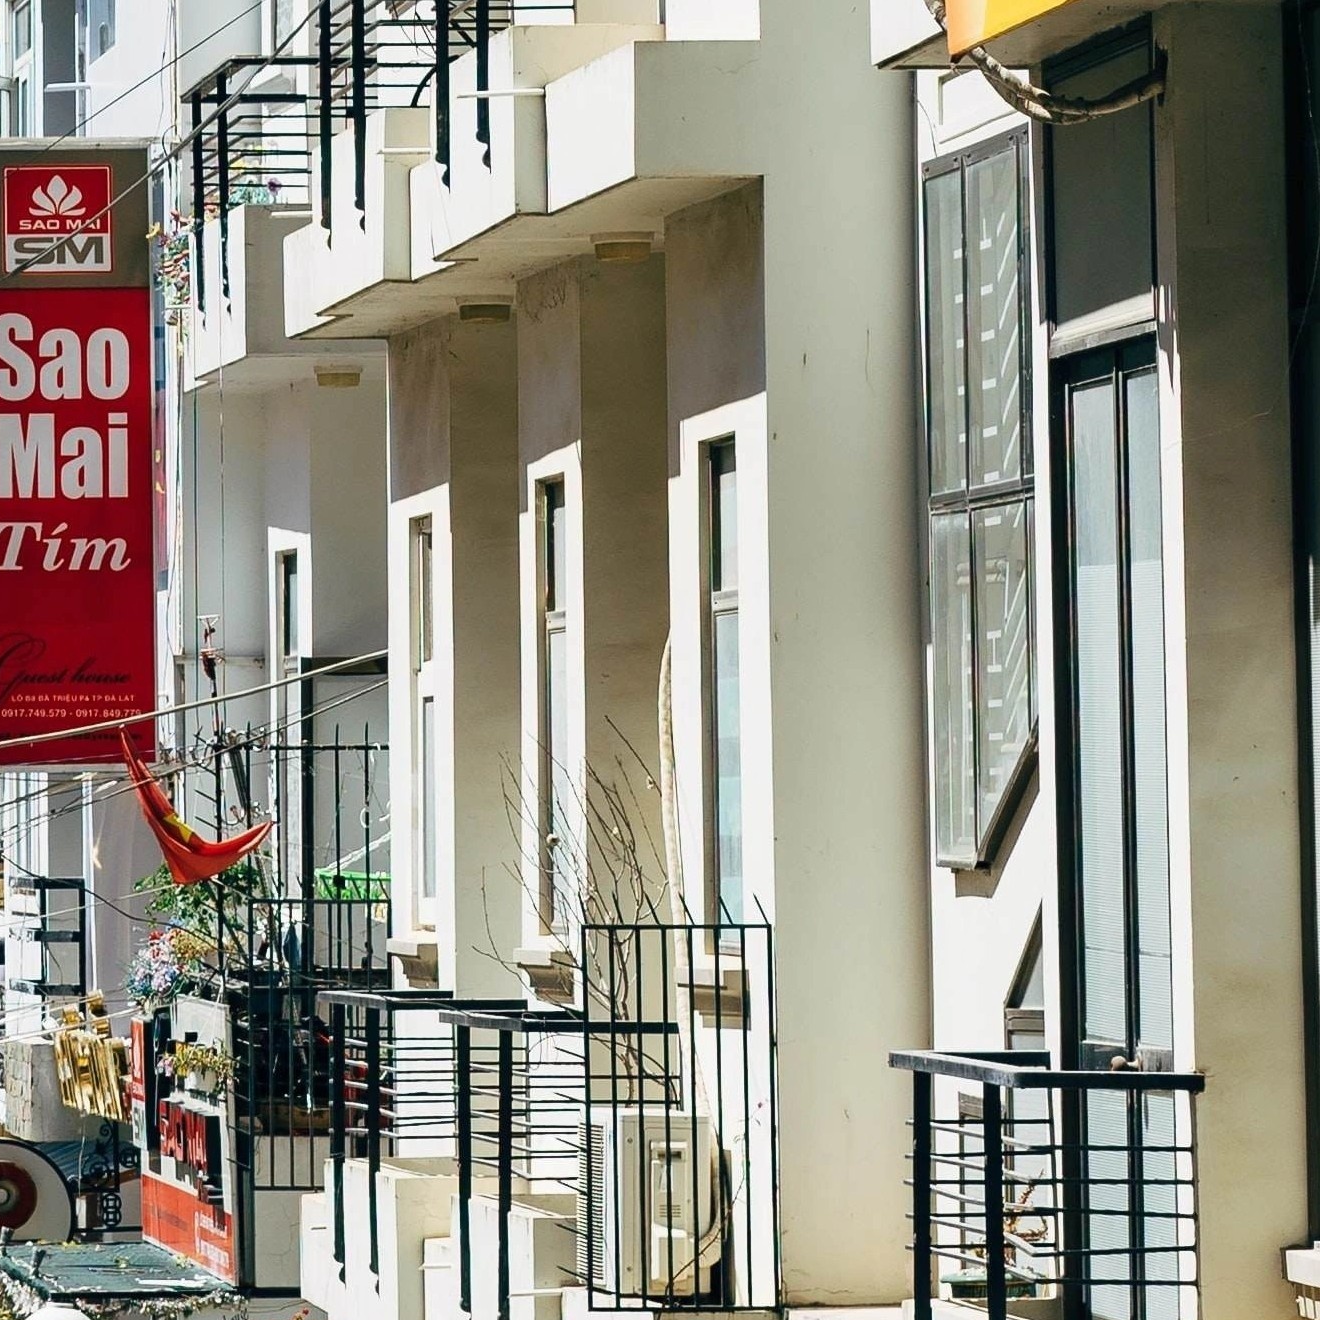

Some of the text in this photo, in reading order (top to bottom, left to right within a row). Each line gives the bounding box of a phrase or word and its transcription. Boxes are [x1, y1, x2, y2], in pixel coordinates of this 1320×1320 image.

[19, 219, 100, 230] SAO MAI
[13, 236, 104, 265] SM
